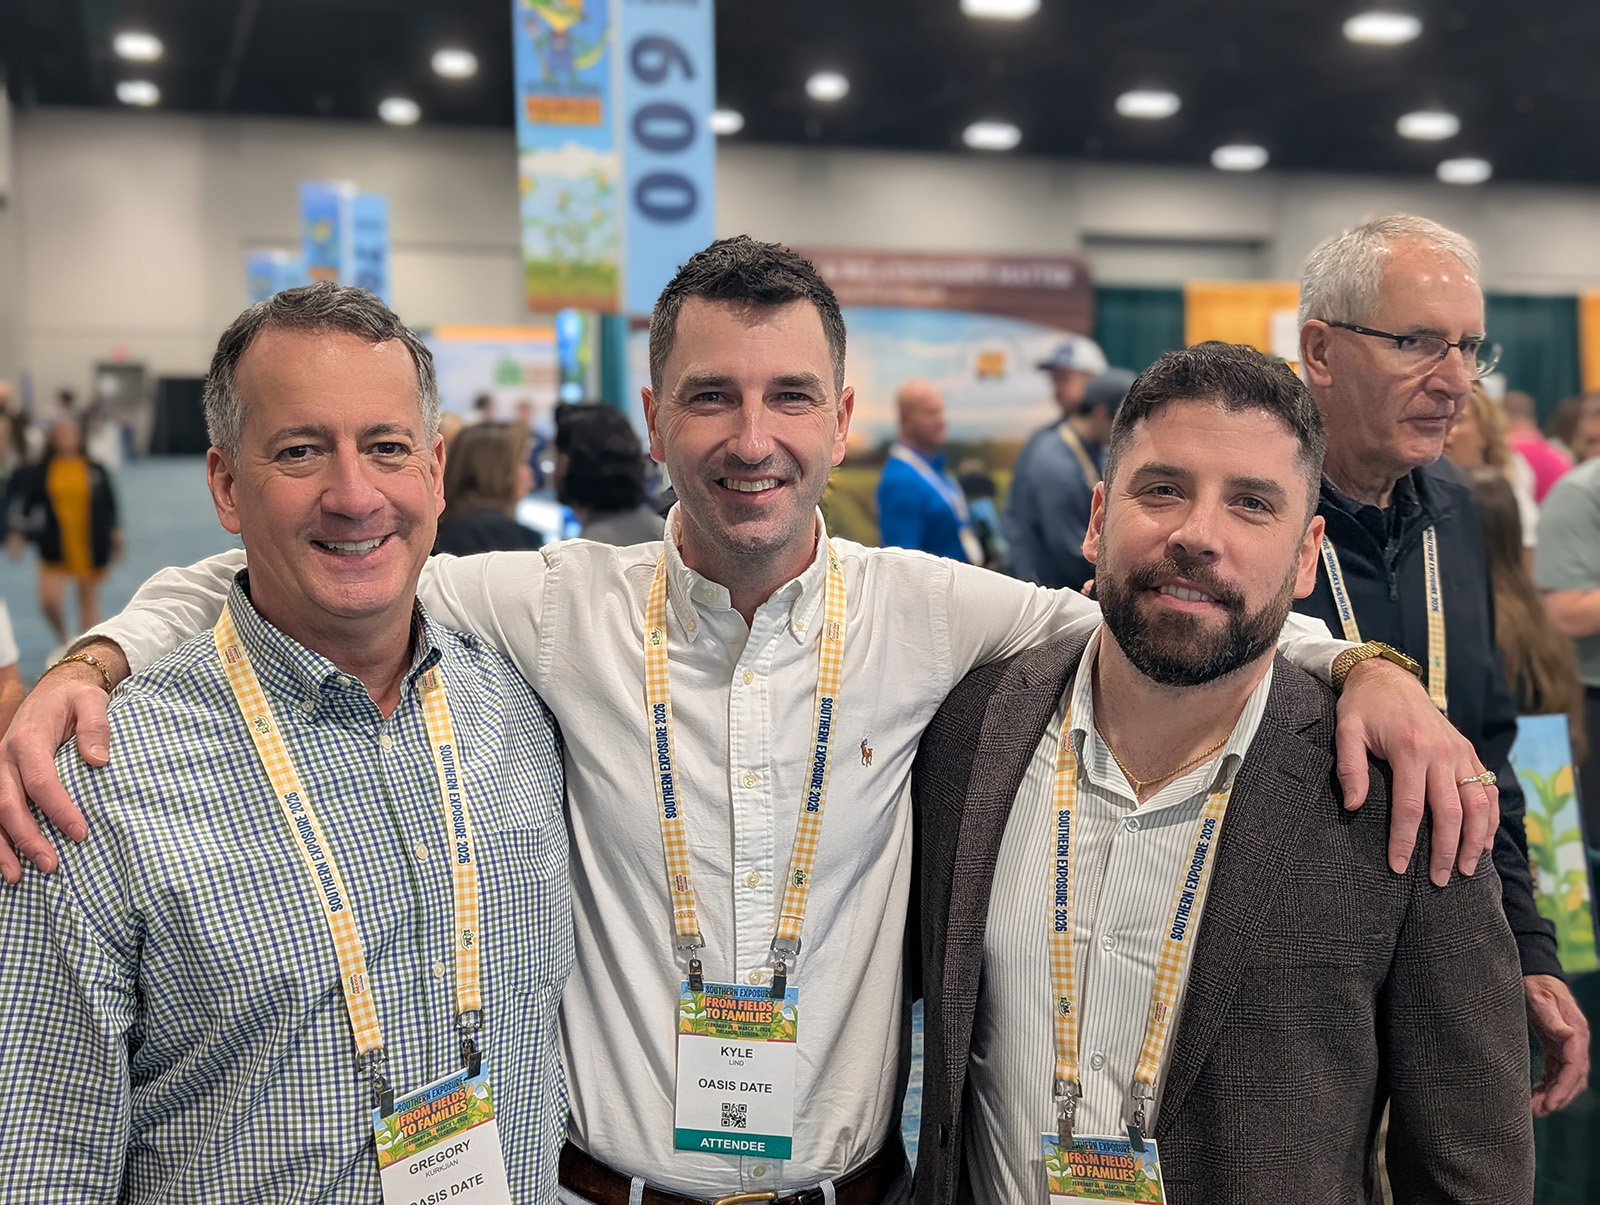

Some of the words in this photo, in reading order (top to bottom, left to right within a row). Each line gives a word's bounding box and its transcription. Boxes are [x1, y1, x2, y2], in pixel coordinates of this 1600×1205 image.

[631, 33, 699, 222] 600
[653, 703, 666, 725] 2026
[818, 697, 833, 743] SOUTHERN
[656, 725, 671, 771] EXPOSURE
[439, 744, 459, 790] SOUTHERN
[811, 744, 828, 790] EXPOSURE
[284, 792, 304, 814] 2026
[661, 773, 677, 819] SOUTHERN
[806, 790, 821, 813] 2026
[449, 792, 467, 840] EXPOSURE
[1057, 809, 1071, 857] SOUTHERN
[294, 813, 325, 861] EXPOSURE
[456, 841, 471, 864] 2026
[314, 861, 343, 912] SOUTHERN
[1055, 859, 1068, 907] EXPOSURE
[1170, 889, 1195, 941] SOUTHERN
[1184, 841, 1209, 891] EXPOSURE
[1199, 818, 1216, 841] 2026
[1055, 909, 1067, 932] 2026
[705, 985, 738, 998] SOUTHERN
[706, 997, 736, 1010] FROM
[738, 1000, 773, 1012] FIELDS
[706, 1008, 720, 1019] TO
[721, 1009, 773, 1023] FAMILIES
[720, 1046, 753, 1058] KYLE
[397, 1092, 431, 1113] SOUTHERN
[431, 1076, 463, 1098] EXPOSURE
[698, 1078, 736, 1091] OASIS
[740, 1082, 773, 1093] DATE
[400, 1104, 431, 1127] FROM
[432, 1088, 466, 1112] FIELDS
[402, 1123, 417, 1138] TO
[417, 1100, 468, 1132] FAMILIES
[409, 1139, 470, 1175] GREGORY
[700, 1138, 766, 1152] ATTENDEE
[1069, 1152, 1099, 1165] FROM
[1101, 1156, 1134, 1168] FIELDS
[1100, 1141, 1131, 1153] EXPOSURE
[425, 1159, 458, 1178] KURKJIAN
[1070, 1164, 1085, 1176] TO
[1086, 1166, 1136, 1182] FAMILIES
[410, 1189, 447, 1205] ASIS
[450, 1173, 484, 1196] DATE
